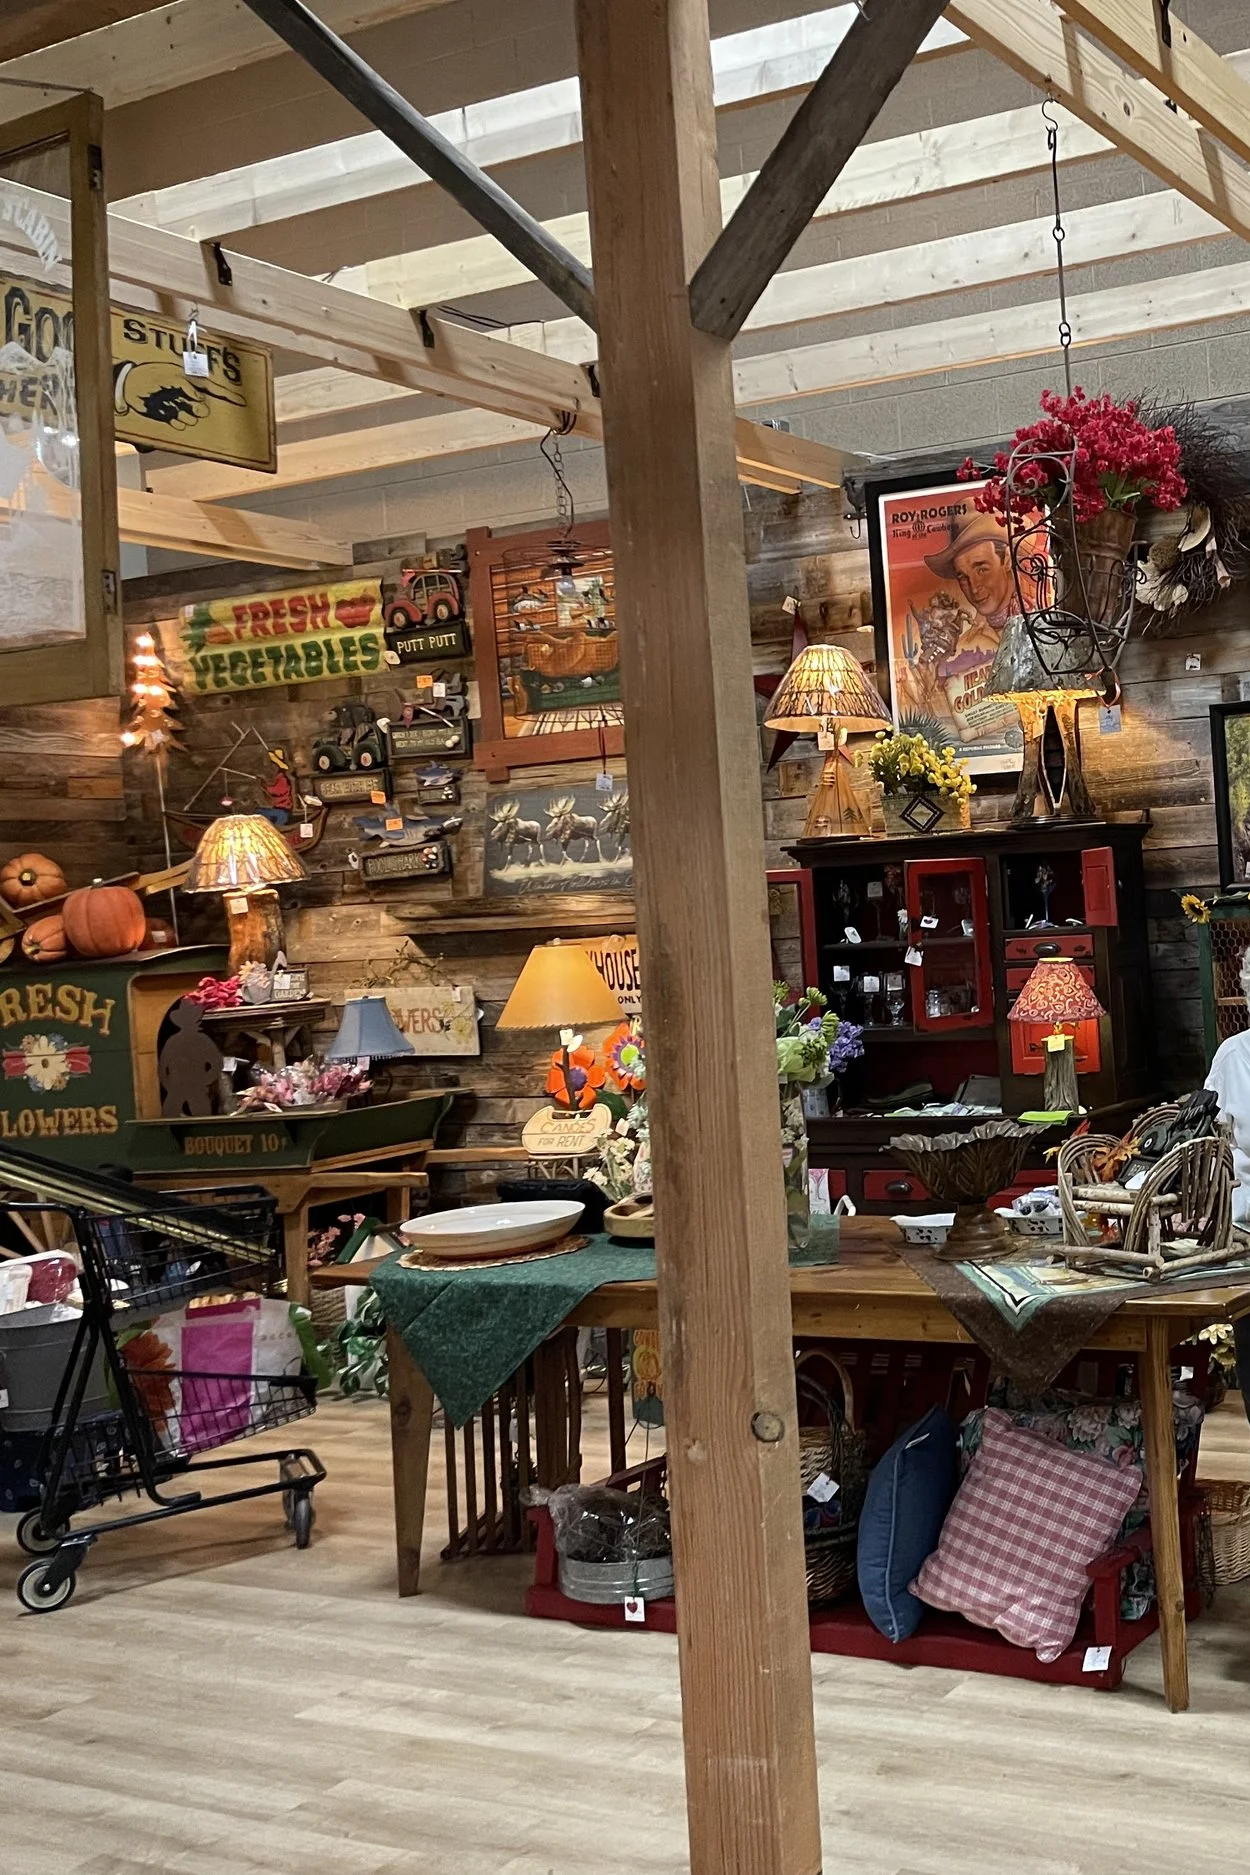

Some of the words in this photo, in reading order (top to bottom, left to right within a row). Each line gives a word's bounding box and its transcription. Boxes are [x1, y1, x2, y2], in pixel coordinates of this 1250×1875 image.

[123, 318, 242, 386] STUF'S
[892, 511, 916, 525] ROY
[920, 504, 967, 521] ROGERS
[231, 592, 331, 641] FRESH
[396, 638, 424, 655] PUTT
[428, 632, 457, 650] PUTT
[189, 632, 381, 690] VEGETABLES
[585, 947, 641, 992] HOUSE
[0, 983, 116, 1037] RESH
[617, 995, 642, 1005] ONLY
[391, 1007, 443, 1034] OWERS
[0, 1104, 119, 1138] LOWERS
[540, 1119, 597, 1134] CANOES
[184, 1134, 254, 1157] BOUQUET
[537, 1137, 555, 1147] FOR
[557, 1134, 587, 1148] RENT
